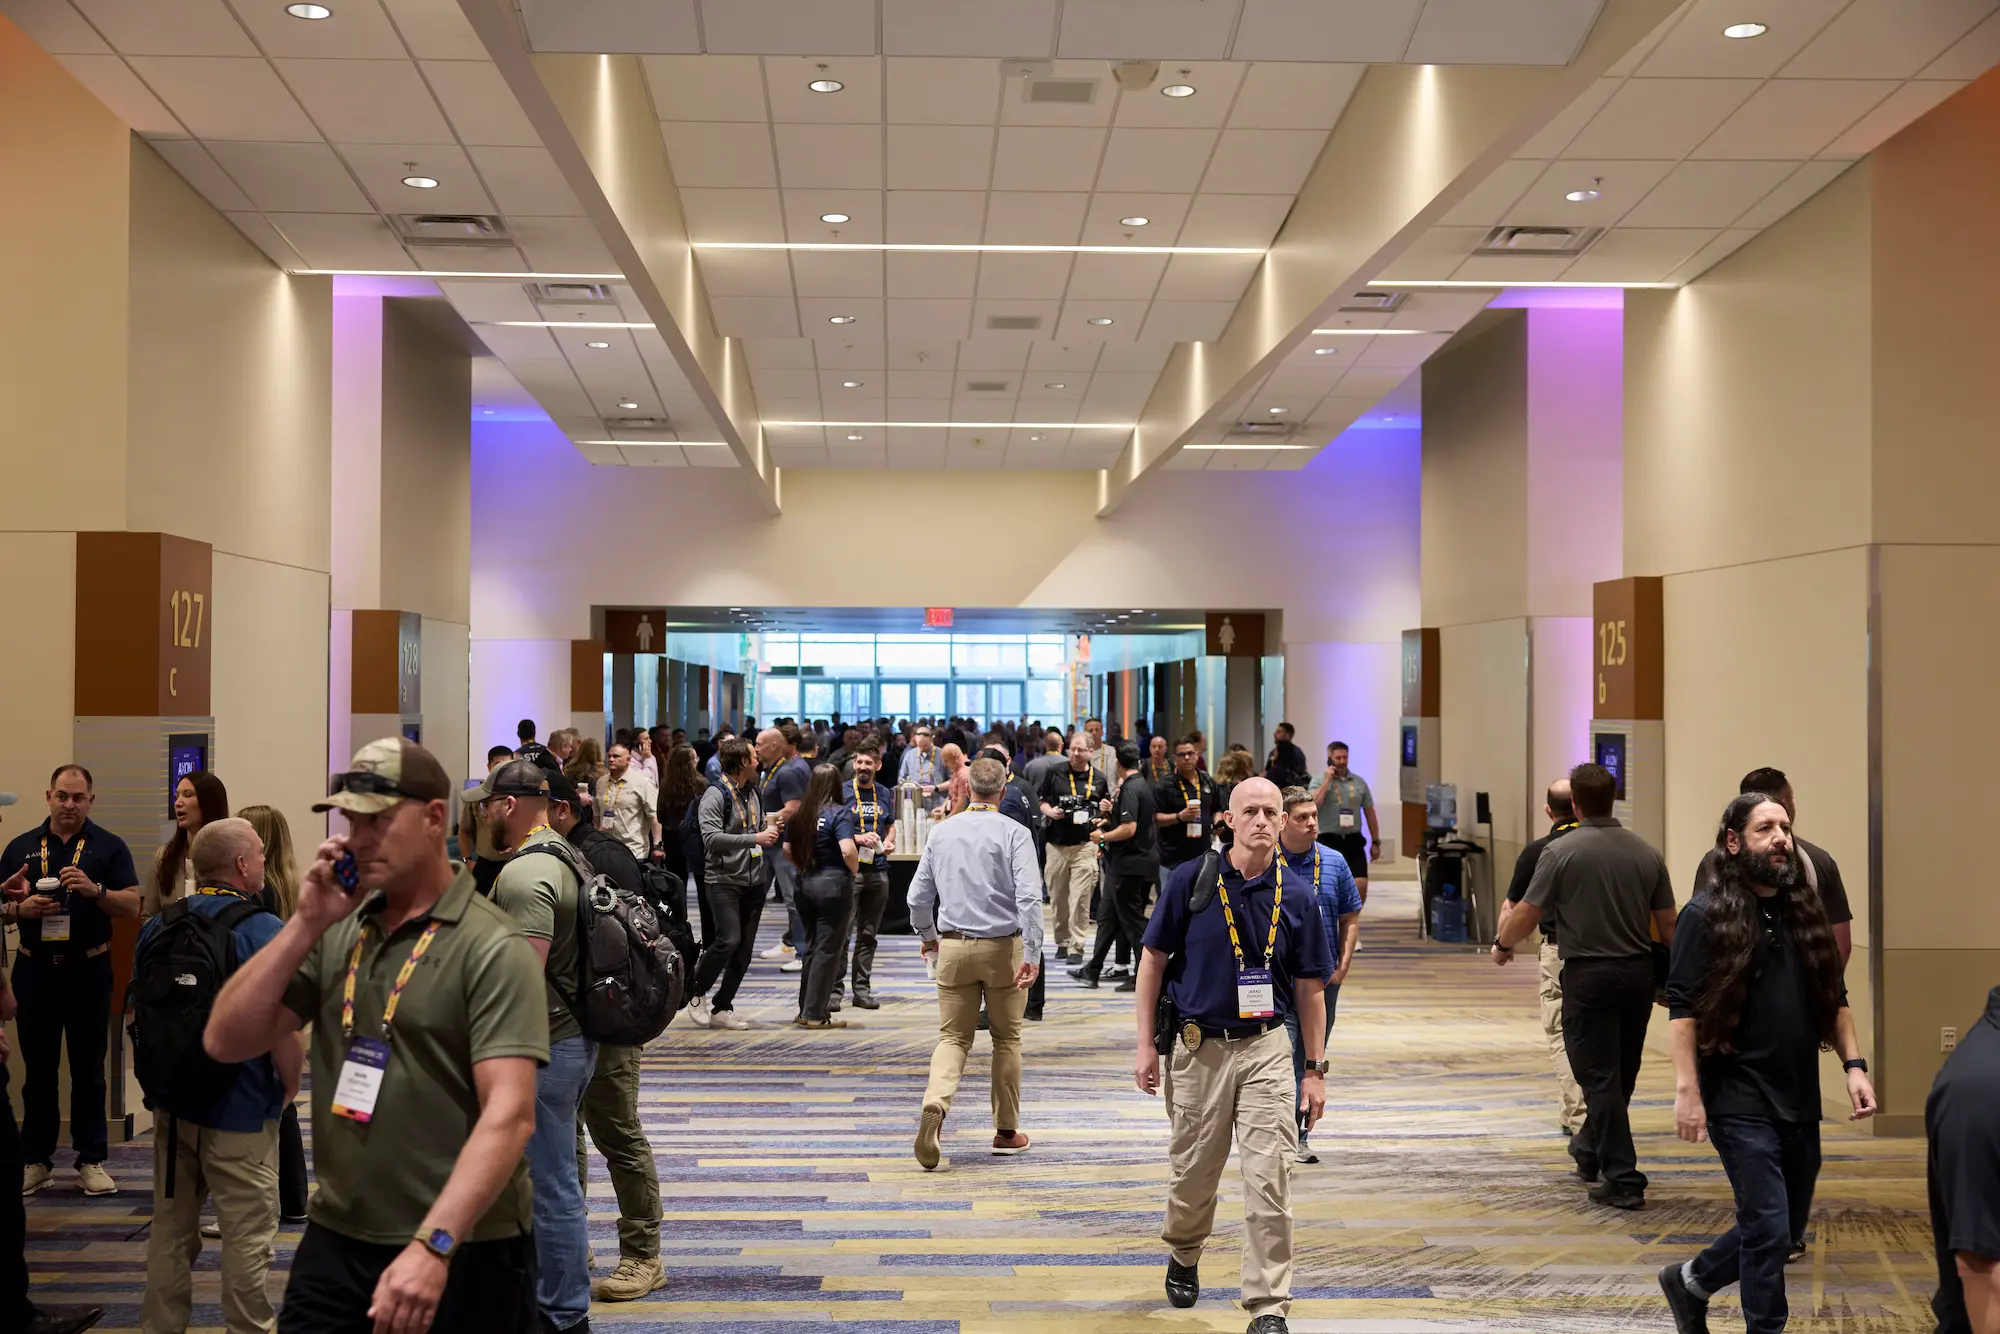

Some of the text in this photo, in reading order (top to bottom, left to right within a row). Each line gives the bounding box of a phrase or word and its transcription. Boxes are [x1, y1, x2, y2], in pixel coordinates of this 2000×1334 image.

[170, 590, 204, 648] 127
[402, 642, 418, 675] 128
[1599, 620, 1627, 666] 125
[1599, 672, 1607, 704] b
